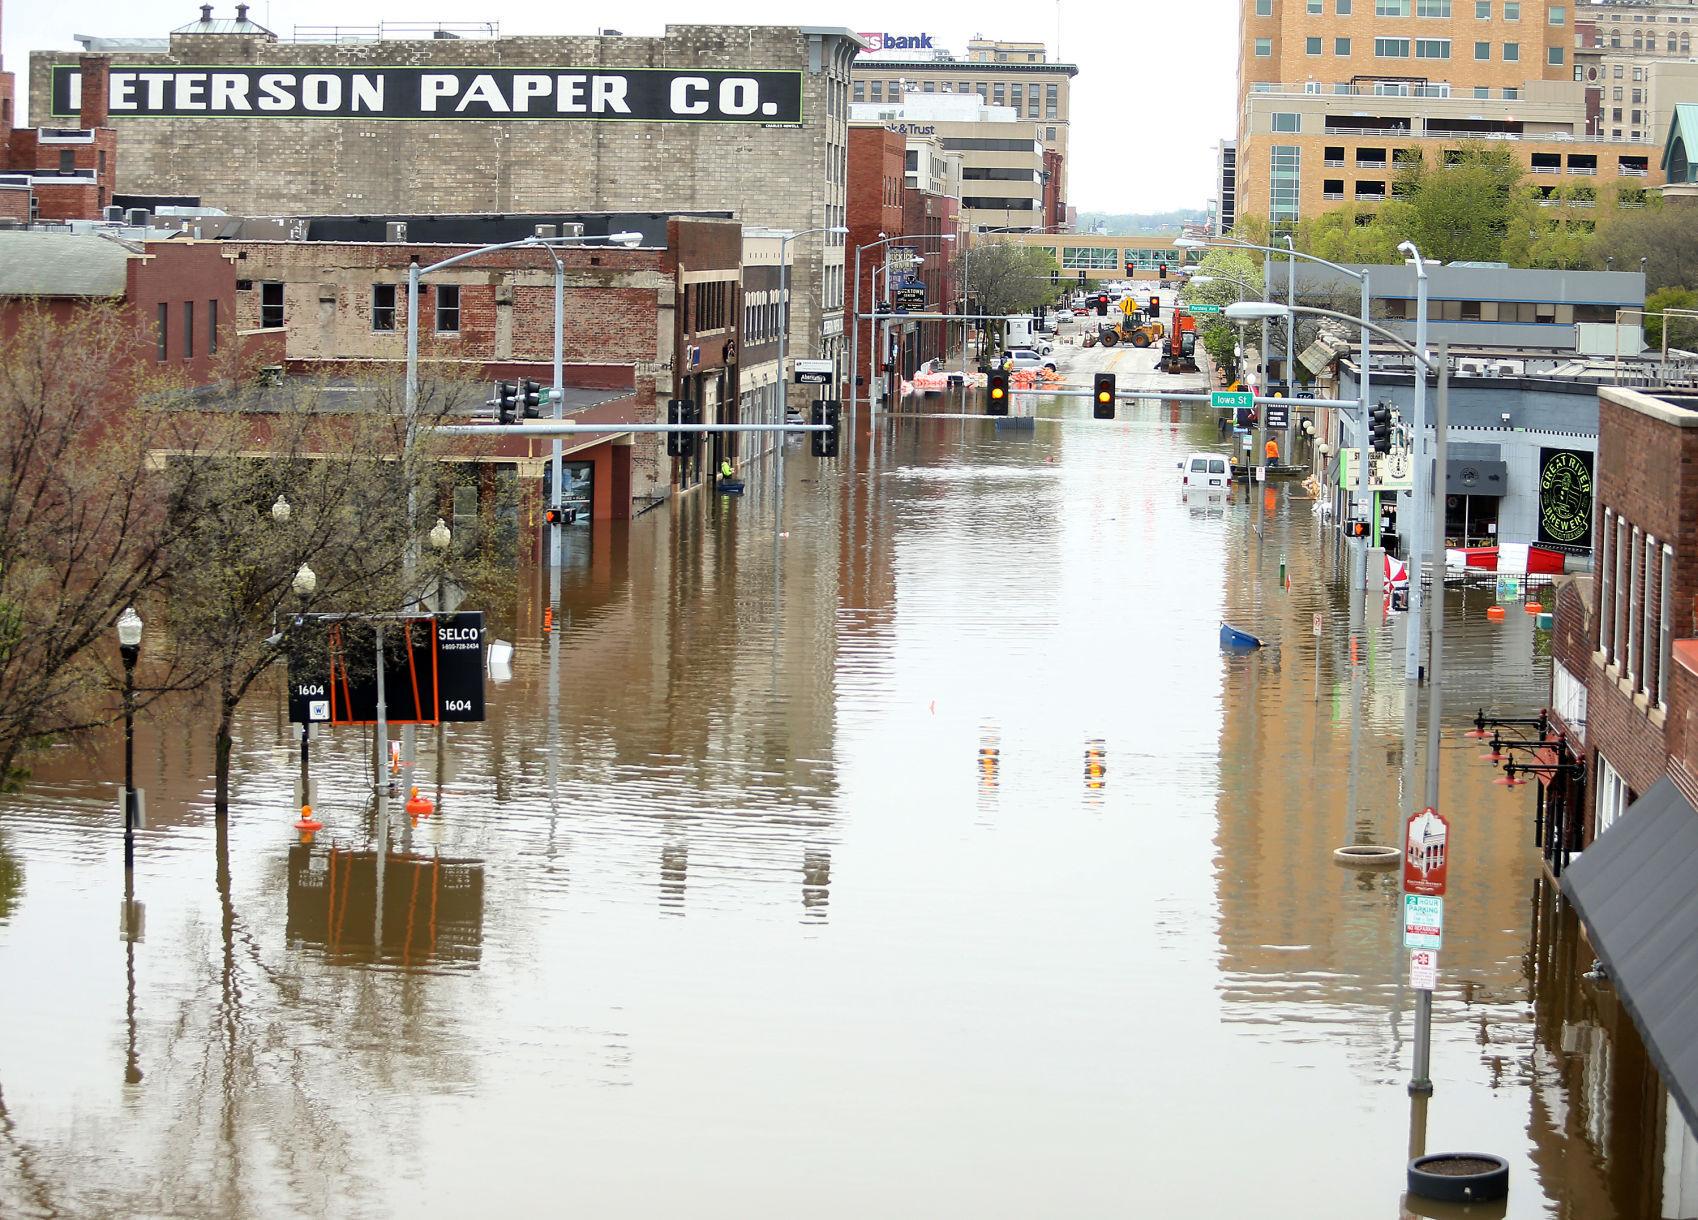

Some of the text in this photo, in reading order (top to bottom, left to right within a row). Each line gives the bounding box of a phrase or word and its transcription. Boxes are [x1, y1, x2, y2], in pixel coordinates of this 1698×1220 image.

[420, 74, 632, 113] PAPER
[669, 76, 778, 116] CO.
[898, 124, 907, 134] &
[908, 124, 935, 135] Trust
[1217, 396, 1248, 405] Iowa St
[1543, 456, 1590, 493] GREAT RIVER
[1546, 507, 1585, 531] BREWERY
[438, 628, 478, 641] SELCO
[299, 684, 325, 696] 1604
[445, 700, 472, 711] 1604
[1409, 896, 1439, 907] 2 HOUR
[1409, 906, 1438, 914] PARKING
